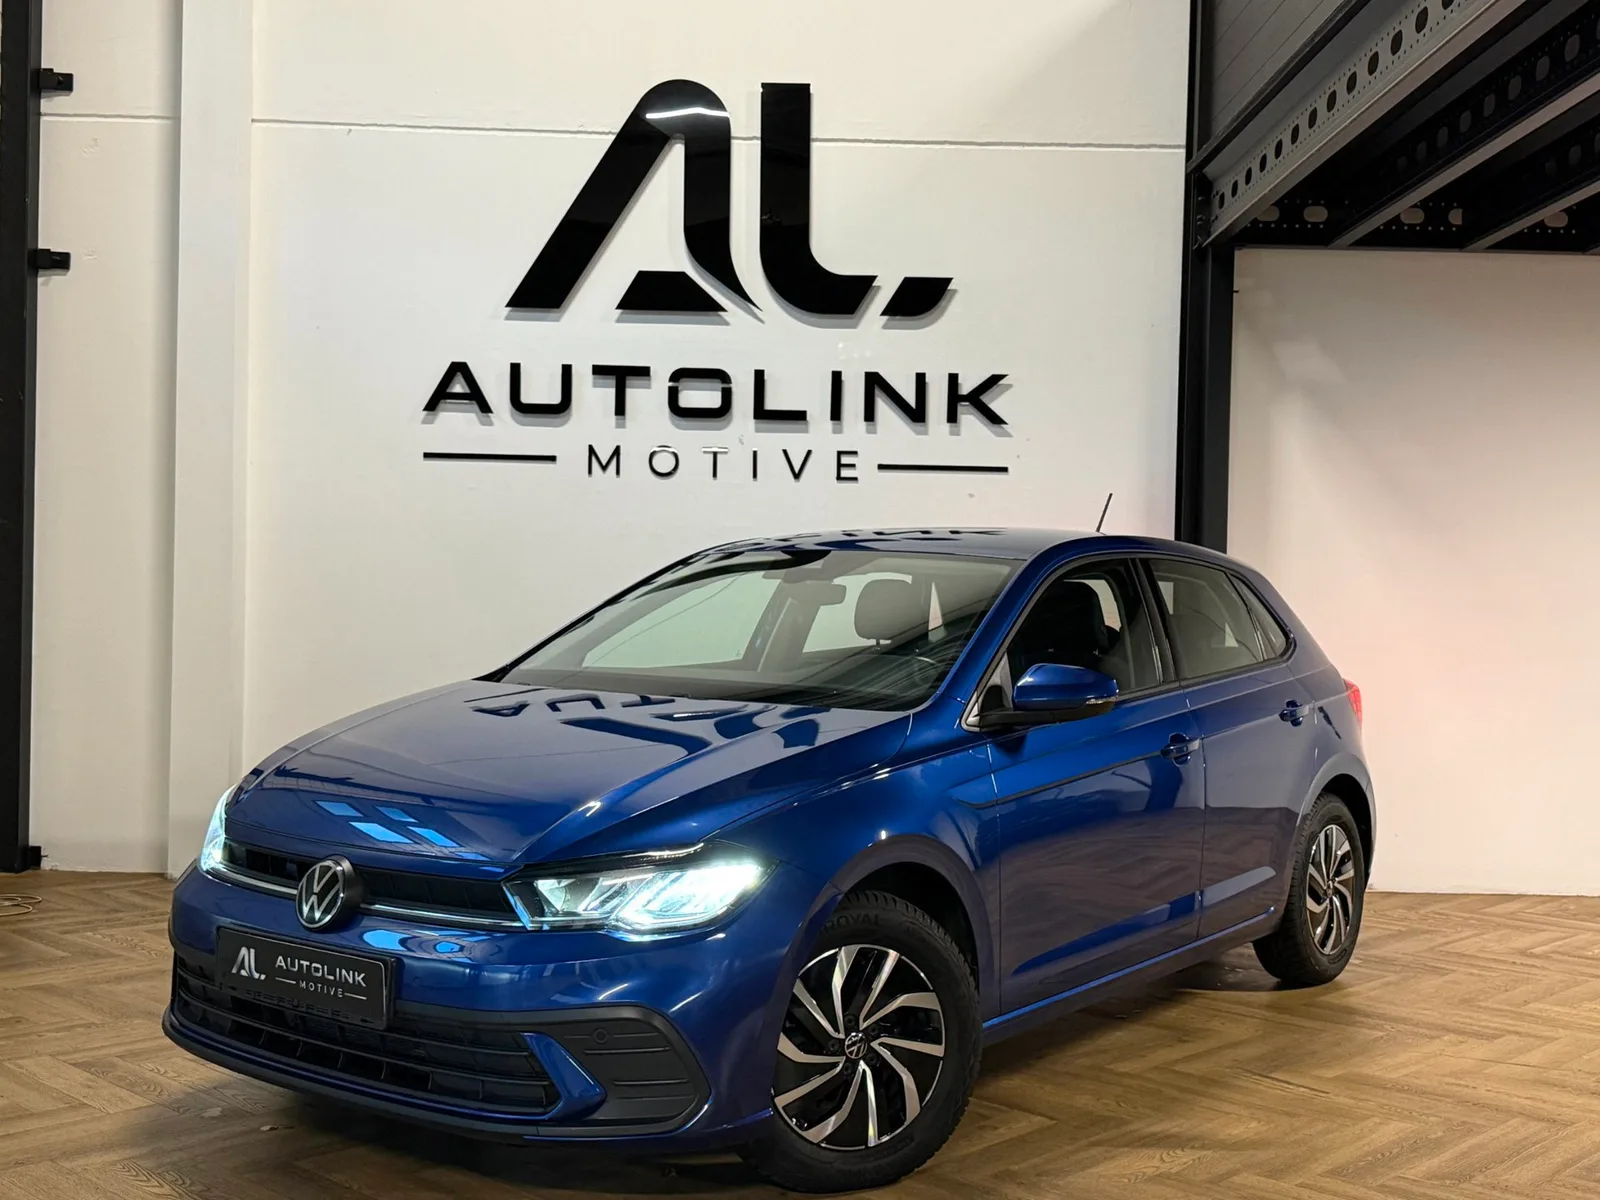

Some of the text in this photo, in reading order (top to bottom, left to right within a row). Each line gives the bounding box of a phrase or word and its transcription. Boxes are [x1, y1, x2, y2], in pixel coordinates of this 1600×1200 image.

[422, 361, 1009, 426] AUTOLINK
[587, 444, 860, 482] MOTIVE
[275, 955, 367, 987] AUTOLINK
[299, 980, 343, 998] MOTIVE
